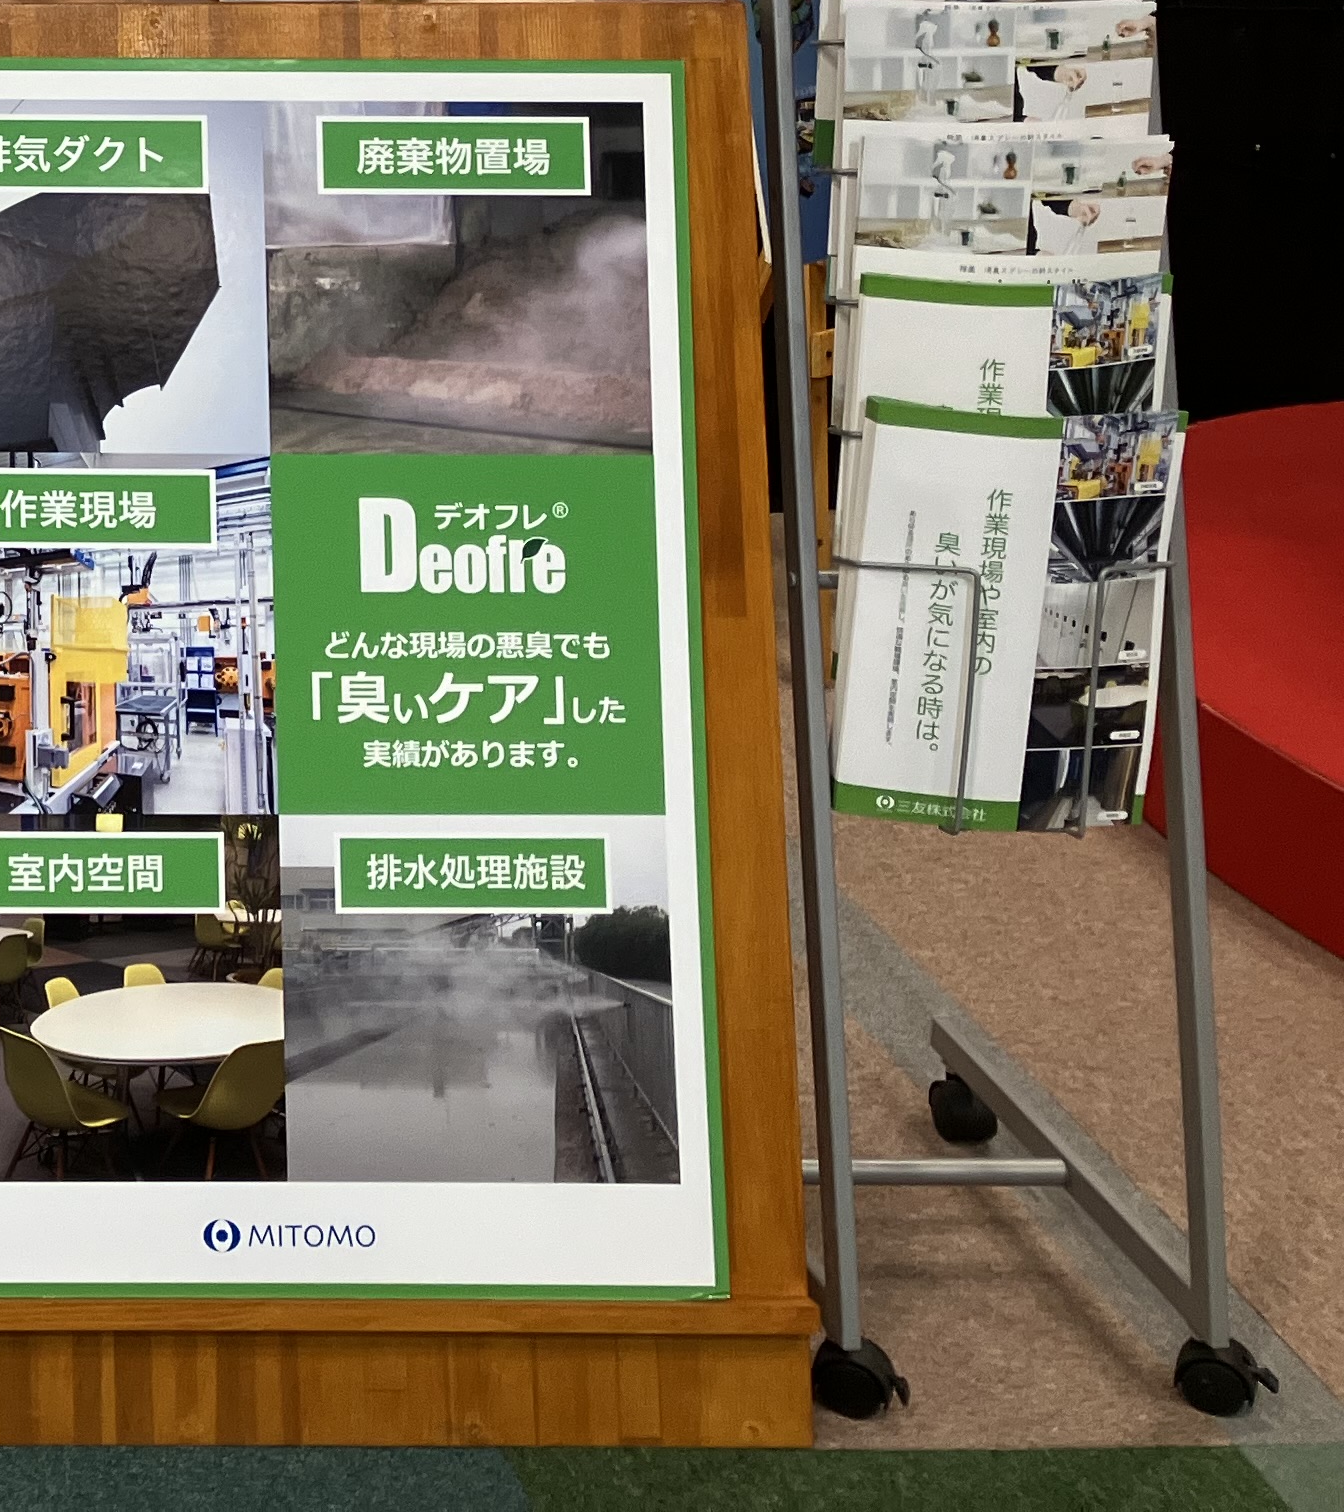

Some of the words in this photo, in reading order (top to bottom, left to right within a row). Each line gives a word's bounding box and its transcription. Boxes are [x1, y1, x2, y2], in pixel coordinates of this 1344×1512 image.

[355, 137, 552, 177] 廃棄物置場
[0, 488, 158, 530] 作業現場
[358, 496, 567, 595] Deofre
[323, 630, 611, 660] どんな現場の悪臭でも
[310, 670, 627, 725] 「臭いケア」した
[362, 738, 580, 769] 実績があります。
[6, 852, 165, 893] 室内空間
[365, 851, 587, 892] 排水処理施設
[248, 1222, 377, 1249] MITOMO
